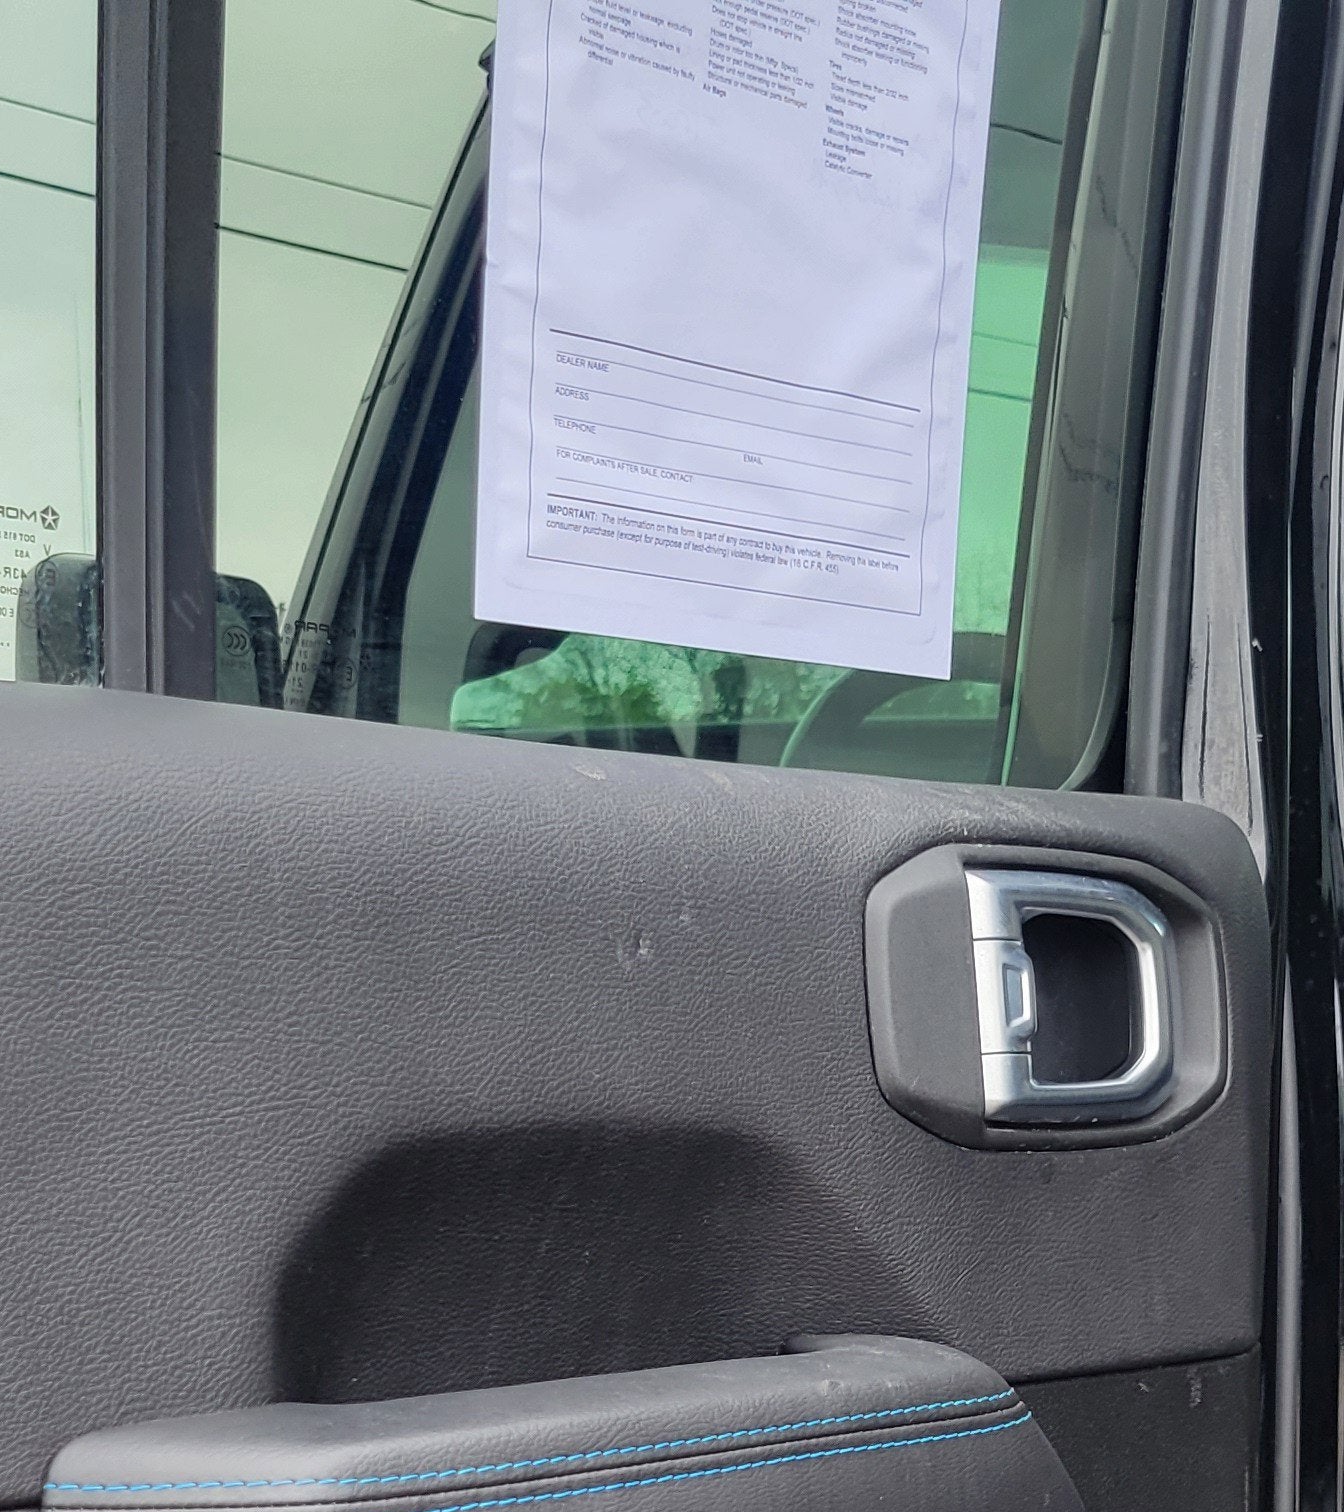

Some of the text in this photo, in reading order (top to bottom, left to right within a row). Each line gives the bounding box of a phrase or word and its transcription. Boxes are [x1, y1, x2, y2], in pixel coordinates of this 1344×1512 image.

[556, 354, 609, 372] DEALER NAME
[555, 387, 589, 400] ADDRESS
[553, 418, 596, 434] TELEPHONE
[556, 449, 570, 458] FOR
[572, 453, 615, 468] COMPLAINTS
[617, 462, 638, 473] AFTER
[660, 470, 692, 482] CONTACT
[743, 454, 763, 465] EMAIL
[547, 504, 597, 521] IMPORTANT:
[602, 513, 614, 524] The
[546, 520, 581, 532] consumer
[582, 526, 614, 538] purchase
[644, 534, 652, 543] for
[654, 538, 682, 548] purpose
[683, 541, 690, 549] of
